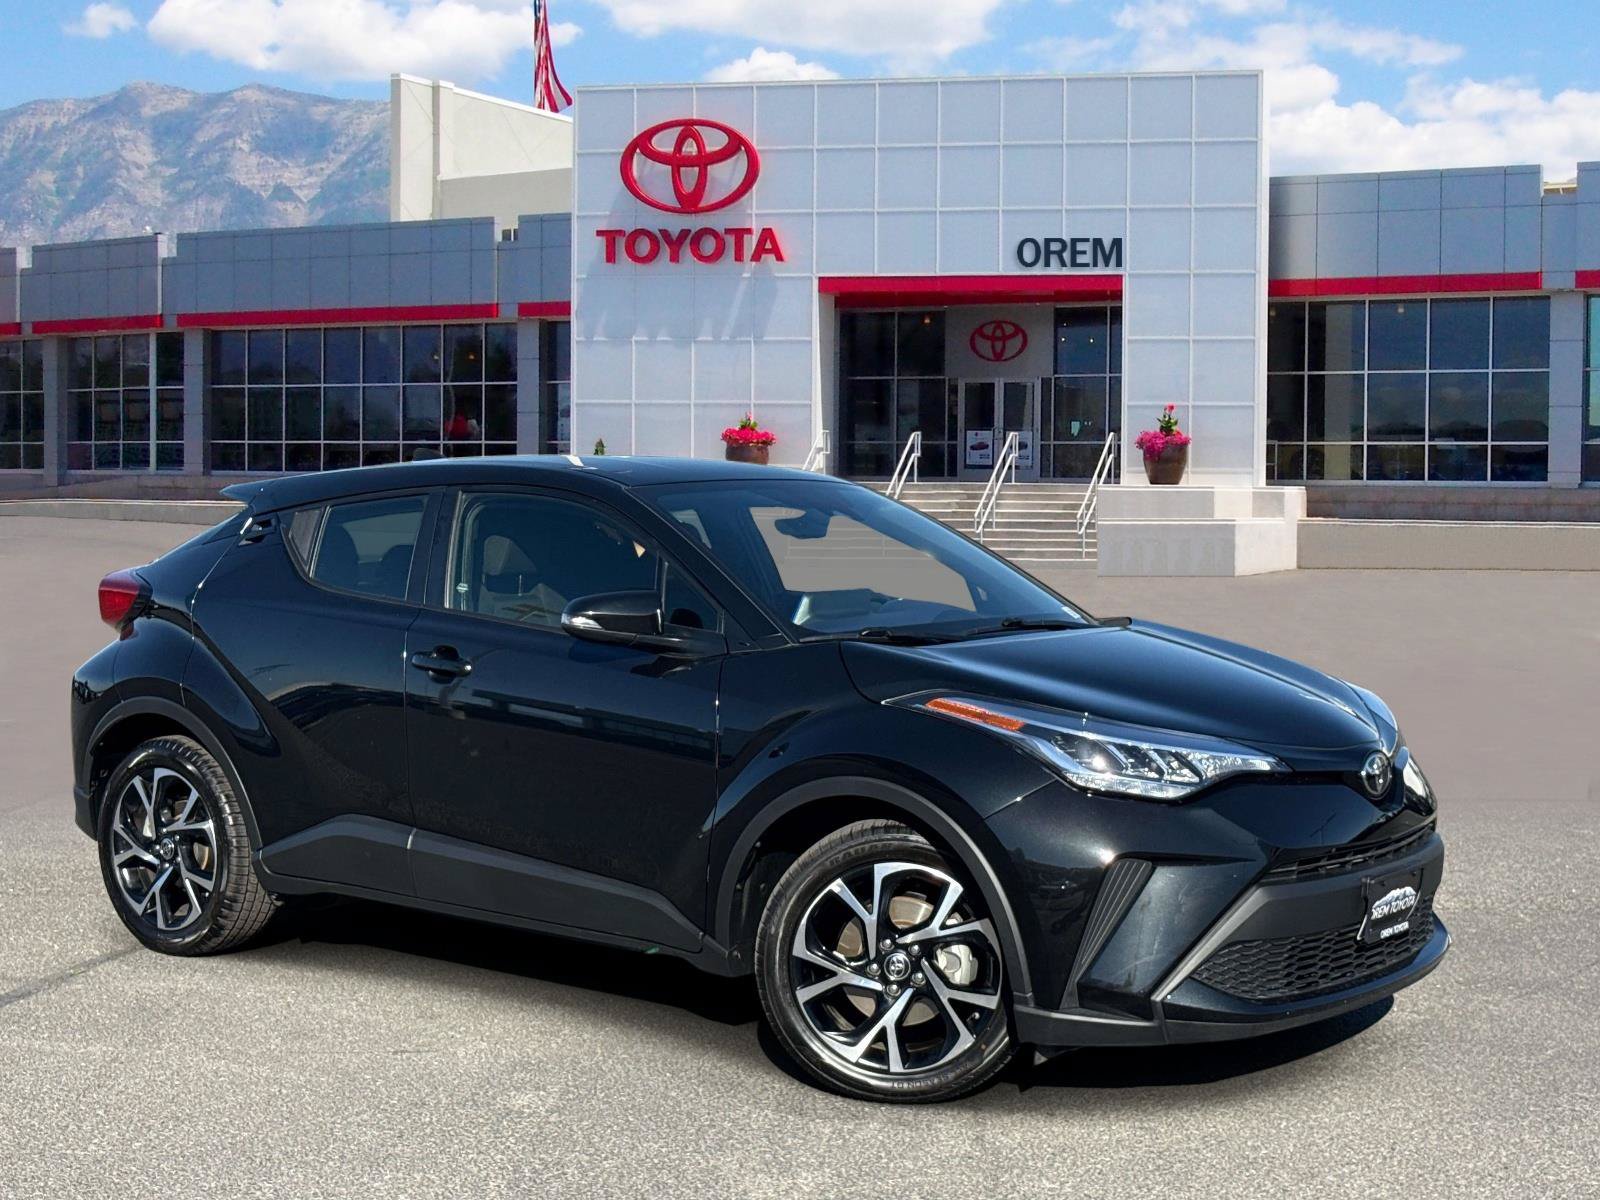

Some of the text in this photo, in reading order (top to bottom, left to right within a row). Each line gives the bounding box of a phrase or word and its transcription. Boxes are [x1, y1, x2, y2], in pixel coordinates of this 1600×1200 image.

[596, 228, 785, 265] TOYOTA
[1017, 237, 1123, 268] OREM
[1390, 896, 1415, 913] TOYOTA
